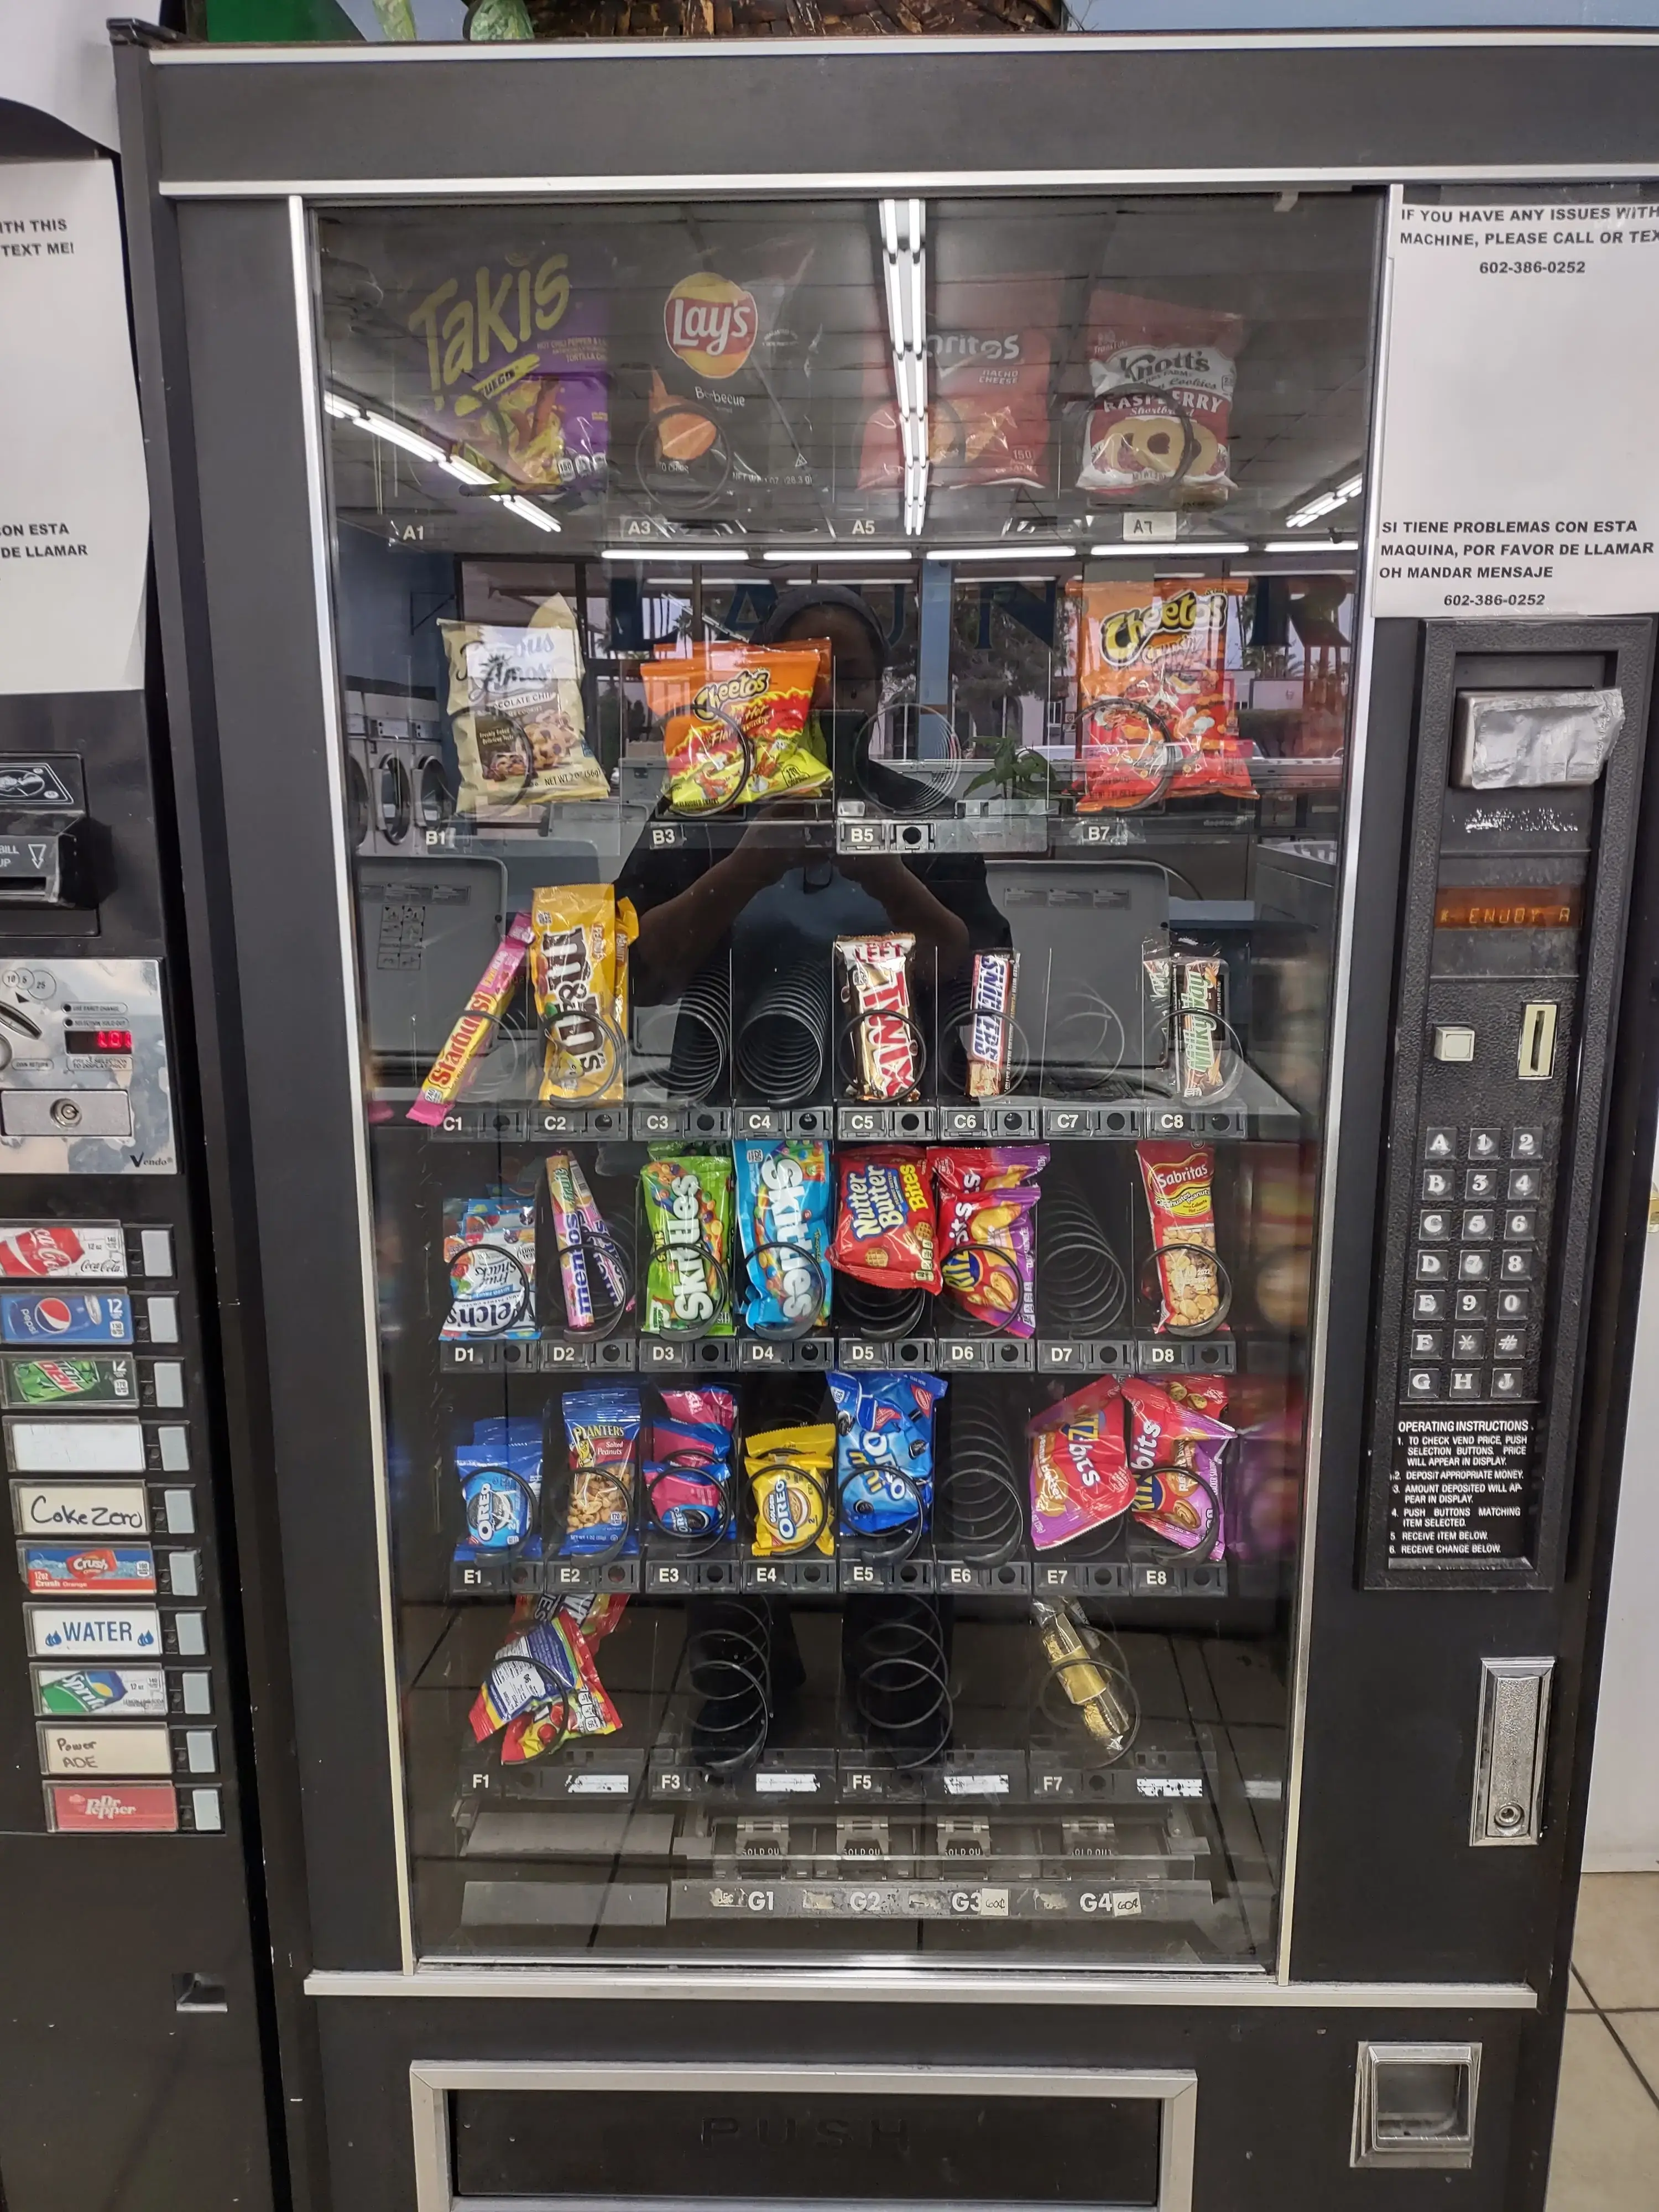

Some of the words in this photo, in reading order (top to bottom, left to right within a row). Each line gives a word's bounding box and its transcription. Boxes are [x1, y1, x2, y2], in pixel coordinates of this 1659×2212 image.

[1401, 209, 1415, 220] IF
[1420, 211, 1453, 223] YOU
[1459, 210, 1504, 222] HAVE
[1510, 209, 1544, 221] ANY
[1551, 208, 1610, 220] ISSUES
[1616, 207, 1659, 219] WITH
[29, 218, 67, 232] THIS
[1400, 233, 1479, 248] MACHINE,
[1485, 232, 1547, 245] PLEASE
[1553, 232, 1594, 244] CALL
[1600, 231, 1623, 243] OR
[0, 243, 41, 257] TEXT
[1480, 262, 1585, 274] 602-386-0252
[672, 300, 750, 355] Lay's
[1120, 351, 1210, 382] Knott's
[29, 523, 69, 536] ESTA
[403, 526, 424, 541] A1
[629, 522, 650, 535] A3
[852, 520, 875, 534] A5
[1134, 519, 1152, 534] A7
[1382, 522, 1397, 533] SI
[1404, 522, 1448, 533] TIENE
[1453, 521, 1550, 533] PROBLEMAS
[1556, 521, 1588, 533] CON
[1594, 520, 1637, 533] ESTA
[1, 547, 20, 558] DE
[25, 545, 88, 558] LLAMAR
[1381, 545, 1458, 558] MAQUINA,
[1464, 544, 1495, 556] POR
[1501, 544, 1554, 556] FAVOR
[1559, 544, 1579, 555] DE
[1584, 542, 1654, 555] LLAMAR
[1380, 567, 1402, 578] OH
[1407, 567, 1472, 578] MANDAR
[1477, 567, 1553, 578] MENSAJE
[1444, 594, 1545, 606] 602-386-0252
[1103, 591, 1227, 664] Cheetos
[693, 670, 769, 721] Cheetos
[426, 831, 445, 844] B1
[653, 830, 675, 844] B3
[851, 828, 874, 842] B5
[1088, 827, 1110, 841] B7
[1469, 907, 1539, 924] ENJOY
[1559, 908, 1570, 922] A
[863, 972, 915, 1097] TWIX
[444, 1117, 461, 1130] C1
[544, 1117, 566, 1130] C2
[647, 1115, 668, 1129] C3
[749, 1115, 770, 1129] C4
[852, 1115, 873, 1129] C5
[954, 1115, 976, 1129] C6
[1058, 1114, 1078, 1128] C7
[1161, 1114, 1183, 1128] C8
[1158, 1164, 1208, 1189] Sabritas
[900, 1164, 928, 1212] Bites
[868, 1165, 904, 1229] Butter
[849, 1172, 882, 1239] Nutter
[761, 1159, 813, 1318] Skittles
[671, 1174, 714, 1321] Skittles
[107, 1298, 123, 1313] 12
[20, 1308, 39, 1335] pepsi
[455, 1348, 473, 1361] D1
[554, 1347, 574, 1360] D2
[653, 1347, 674, 1360] D3
[753, 1346, 773, 1359] D4
[853, 1347, 874, 1359] D5
[952, 1347, 973, 1359] D6
[1051, 1348, 1072, 1361] D7
[1152, 1349, 1174, 1362] D8
[572, 1426, 624, 1439] PLANTERS
[1399, 1421, 1454, 1432] OPERATING
[1455, 1421, 1528, 1432] INSTRUCTIONS
[1131, 1420, 1161, 1469] bits
[1409, 1437, 1419, 1445] TO
[1422, 1437, 1449, 1445] CHECK
[1453, 1436, 1474, 1444] VEND
[1505, 1434, 1527, 1444] PUSH
[1408, 1447, 1452, 1455] SELECTION
[1503, 1446, 1526, 1455] PRICE
[1407, 1458, 1427, 1466] WILL
[1428, 1458, 1460, 1466] APPEAR
[1462, 1457, 1470, 1465] IN
[1473, 1457, 1506, 1465] DISPLAY.
[1406, 1471, 1439, 1480] DEPOSIT
[1440, 1470, 1493, 1480] APPROPRIATE
[1405, 1484, 1439, 1493] AMOUNT
[1442, 1484, 1485, 1493] DEPOSITED
[1488, 1483, 1507, 1492] WILL
[1405, 1495, 1426, 1504] PEAR
[1428, 1495, 1437, 1504] IN
[30, 1495, 88, 1524] Coke
[478, 1483, 493, 1541] OREO
[774, 1479, 796, 1540] OREO
[1404, 1508, 1426, 1517] PUSH
[1434, 1507, 1470, 1516] BUTTONS
[1478, 1507, 1521, 1516] MATCHING
[1403, 1519, 1422, 1527] ITEM
[1402, 1532, 1435, 1541] RECEIVE
[1438, 1531, 1457, 1540] ITEM
[1459, 1531, 1488, 1540] BELOW.
[1401, 1545, 1434, 1553] RECEIVE
[1436, 1545, 1469, 1553] CHANGE
[1472, 1543, 1501, 1553] BELOW.
[74, 1559, 108, 1571] Crush
[464, 1569, 481, 1583] E1
[561, 1569, 580, 1582] E2
[659, 1568, 679, 1582] E3
[757, 1568, 776, 1581] E4
[854, 1567, 874, 1582] E5
[951, 1568, 971, 1582] E6
[1048, 1571, 1068, 1583] E7
[1146, 1572, 1166, 1584] E8
[62, 1621, 132, 1641] WATER
[56, 1738, 97, 1752] Power
[62, 1756, 98, 1768] ADE
[473, 1774, 489, 1788] F1
[662, 1775, 680, 1789] F3
[853, 1775, 872, 1789] F5
[1044, 1776, 1063, 1791] F7
[85, 1798, 137, 1820] Pepper
[748, 1891, 774, 1911] G1
[851, 1891, 880, 1911] G2
[952, 1892, 981, 1912] G3
[1080, 1893, 1112, 1912] G4
[701, 2117, 909, 2150] PUSH
